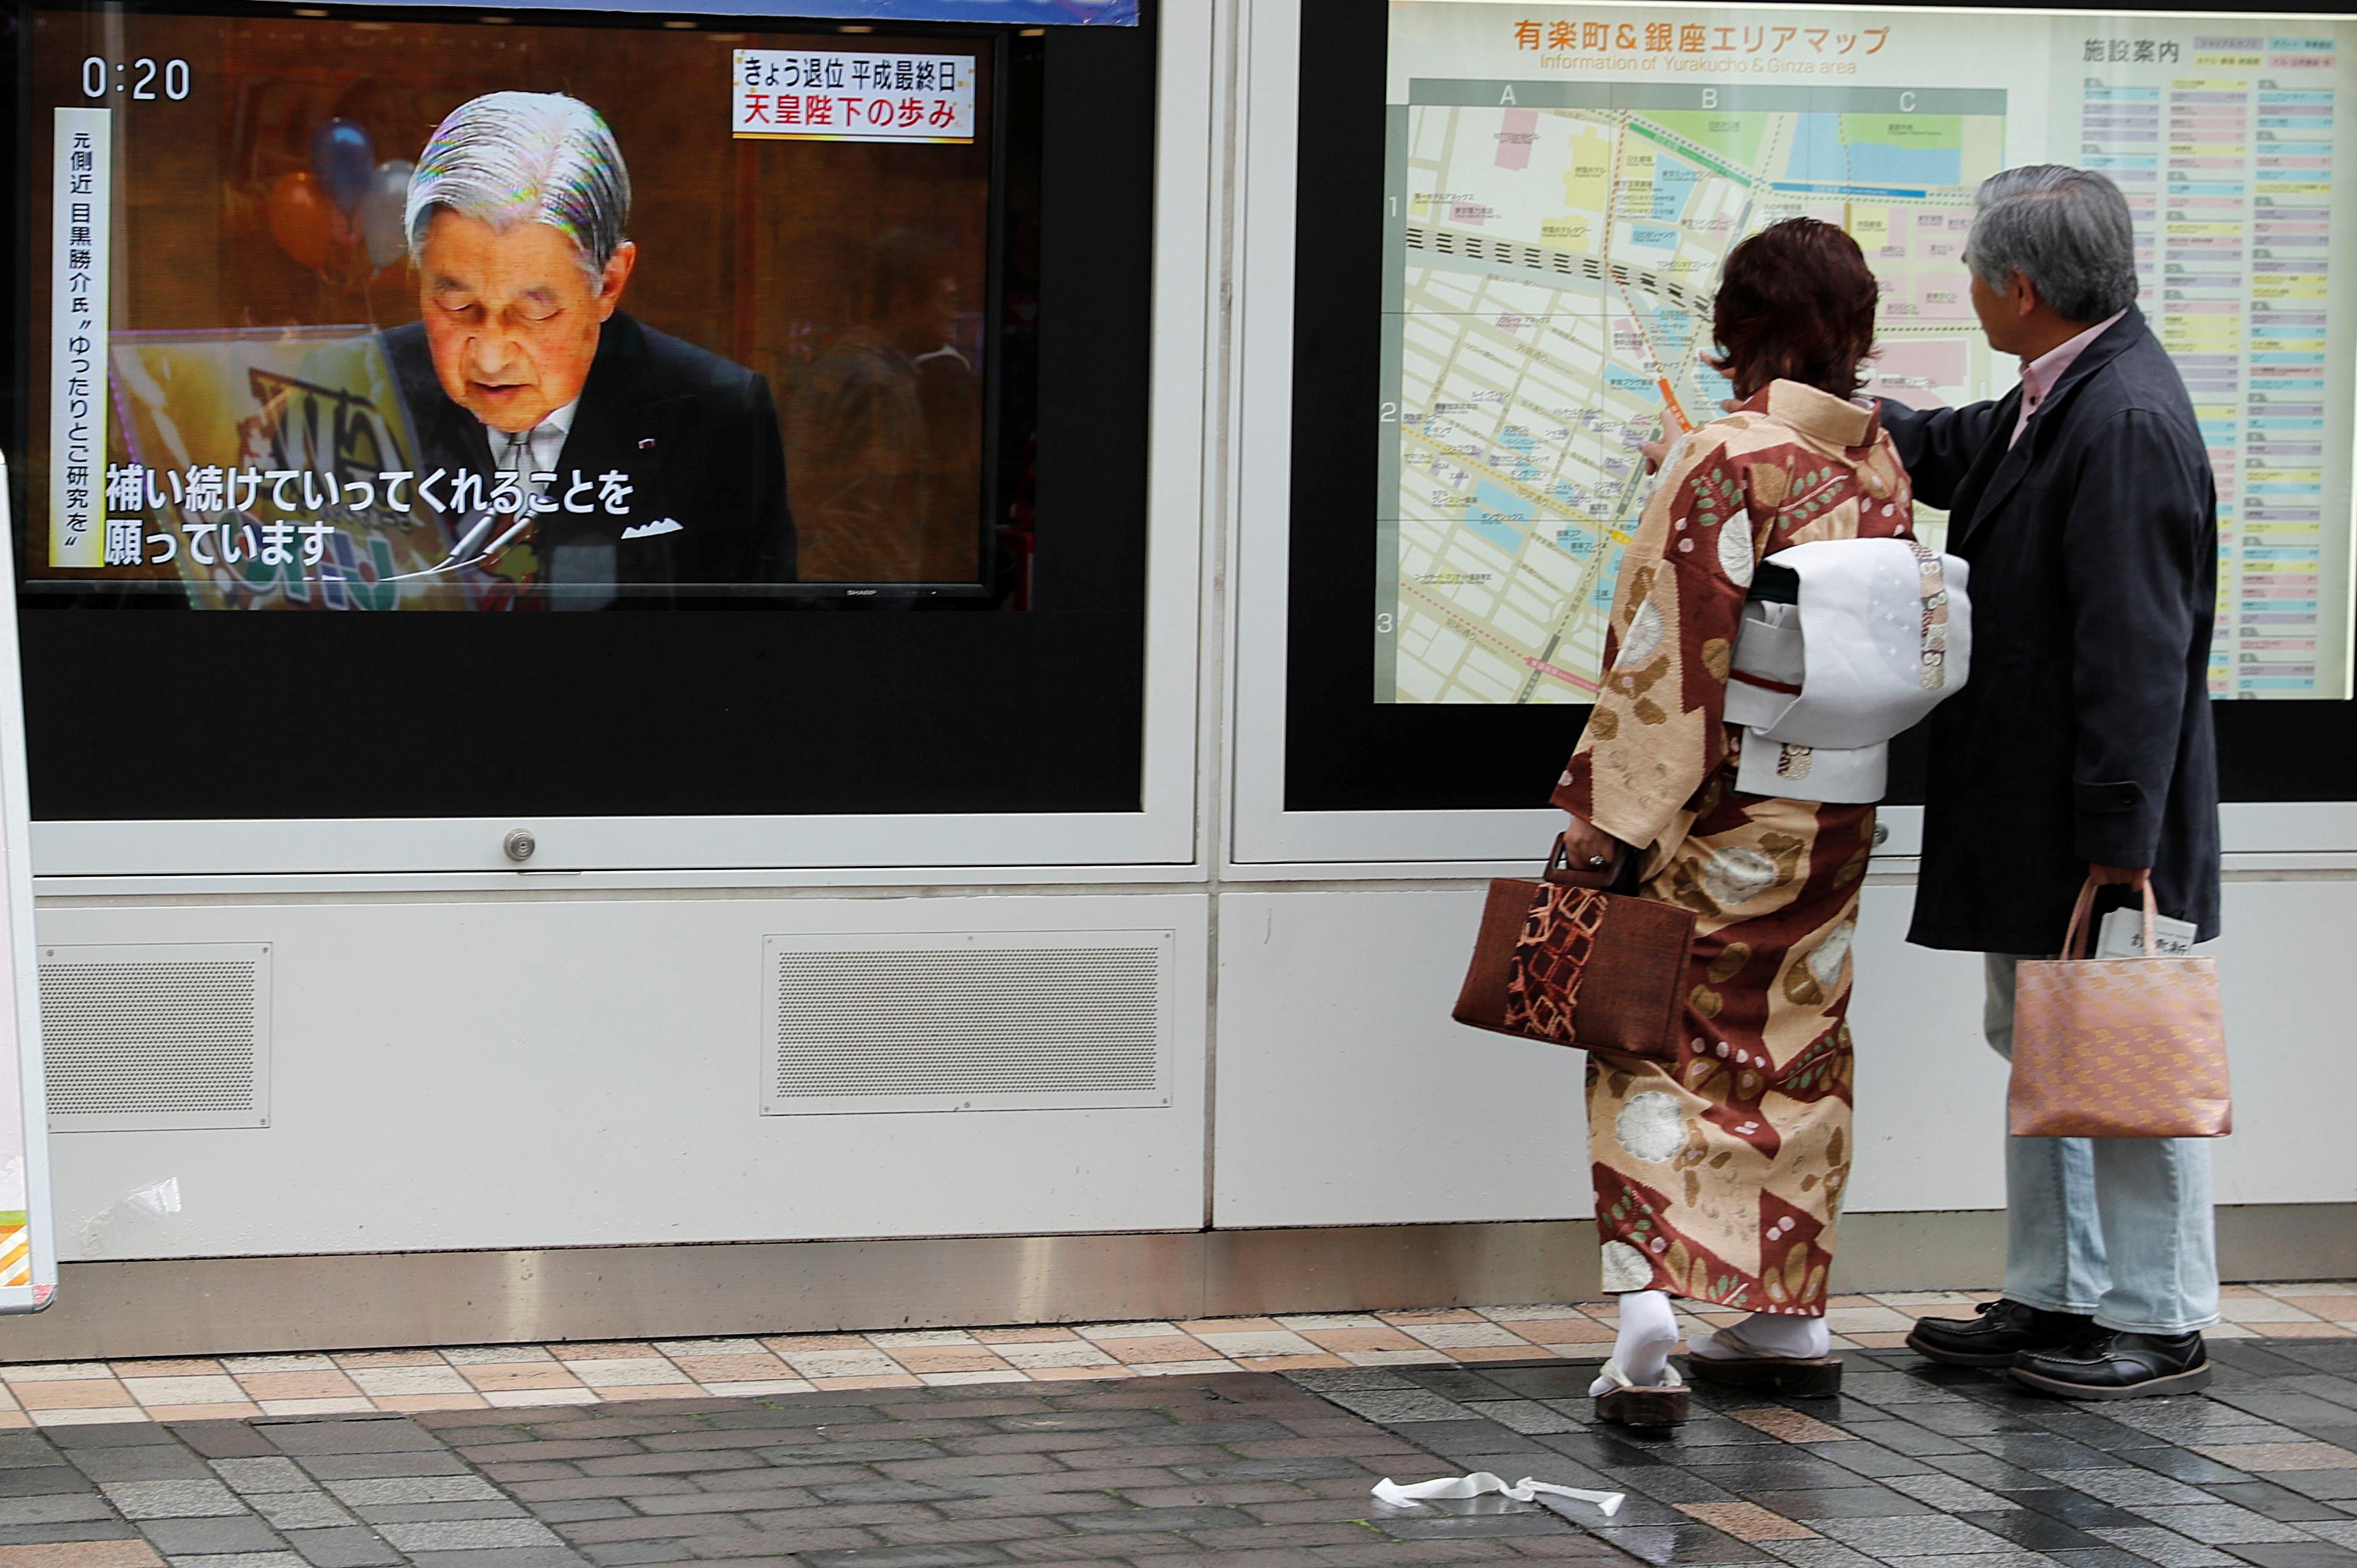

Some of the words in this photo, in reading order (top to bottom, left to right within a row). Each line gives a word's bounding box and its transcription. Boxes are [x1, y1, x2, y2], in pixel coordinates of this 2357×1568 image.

[2082, 38, 2180, 65] 施設案内
[743, 56, 845, 89] きょう退位
[851, 59, 956, 93] 平成最終日
[1540, 54, 1639, 71] Information
[1641, 54, 1657, 71] of
[1664, 55, 1746, 72] Yurakucho
[1753, 58, 1764, 74] &
[1767, 57, 1815, 74] Ginza
[1819, 61, 1857, 75] area
[82, 56, 191, 100] 0:20
[1499, 84, 1518, 105] A
[1702, 88, 1718, 108] B
[1899, 91, 1916, 112] C
[743, 93, 957, 130] 天皇陛下の歩み
[69, 131, 93, 195] 元側近
[1389, 196, 1398, 217] 1
[1379, 402, 1398, 423] 2
[105, 463, 634, 516] 補い続けていってくれることを
[105, 517, 336, 568] 願っています
[1376, 613, 1393, 634] 3
